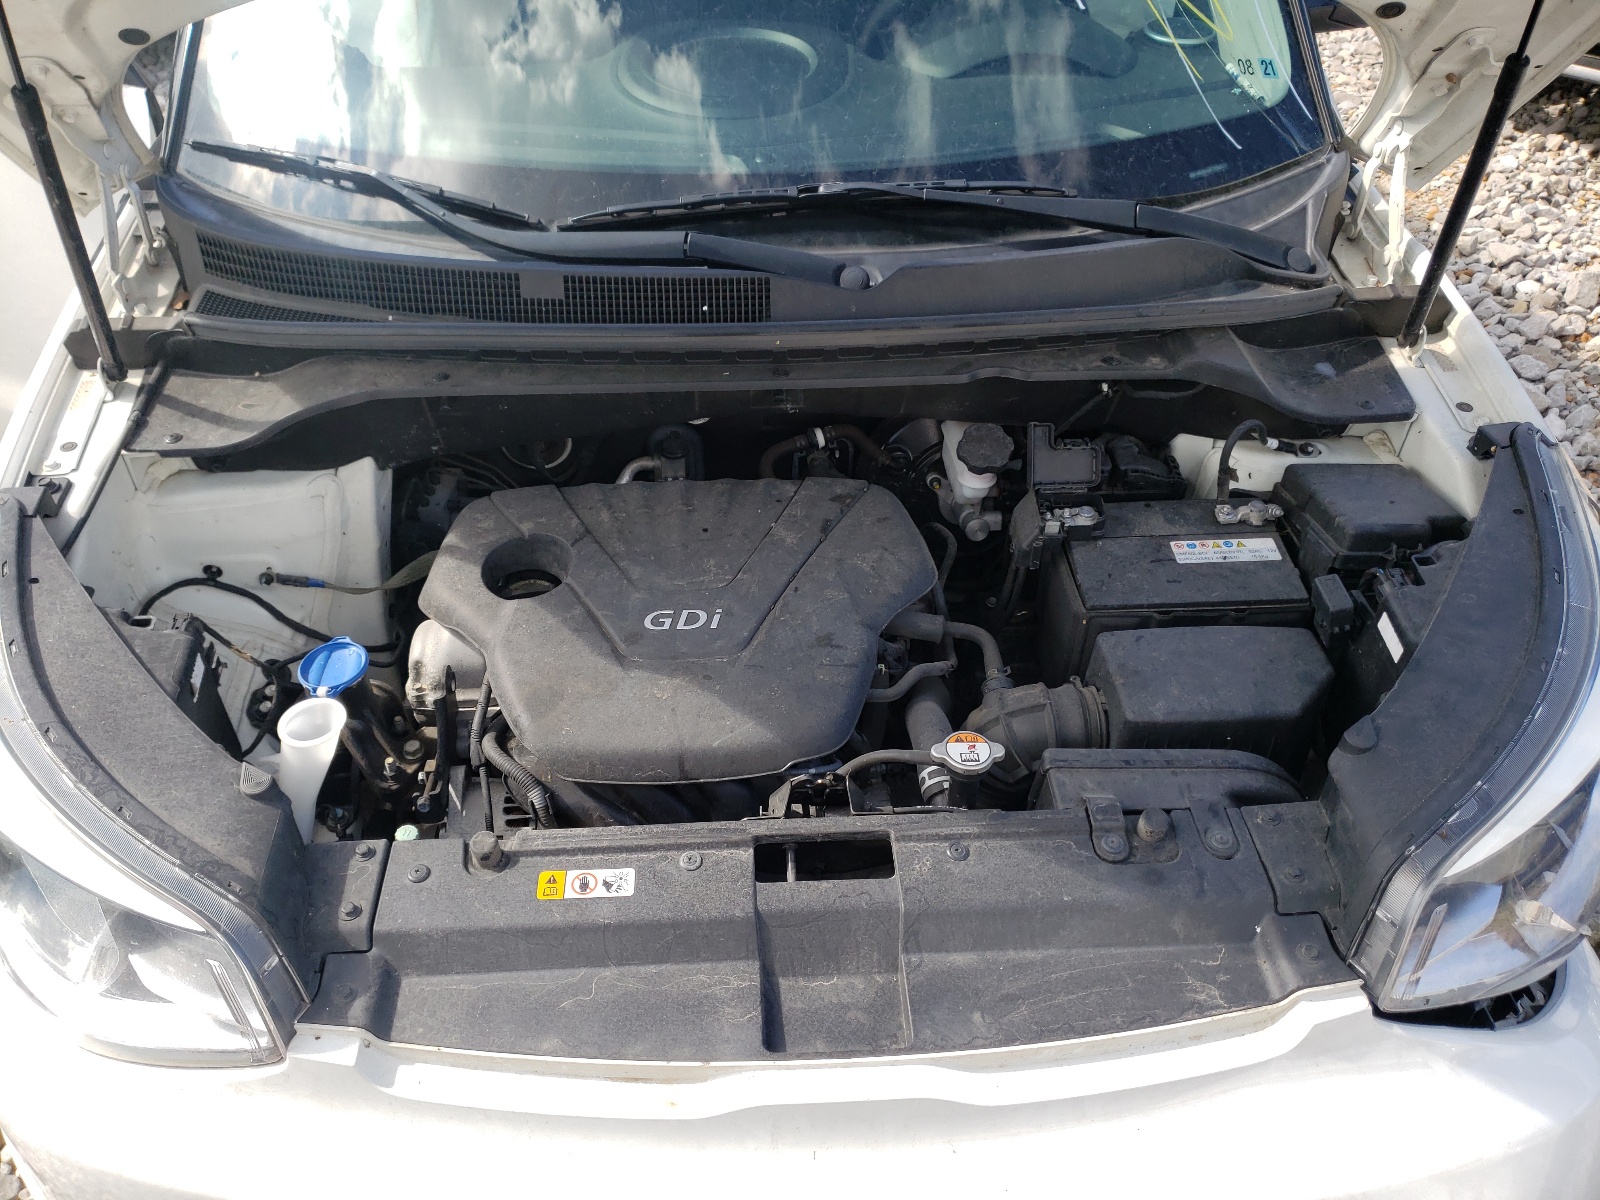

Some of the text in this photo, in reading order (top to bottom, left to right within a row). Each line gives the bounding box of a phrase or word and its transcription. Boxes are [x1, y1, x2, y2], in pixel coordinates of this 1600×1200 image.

[1237, 58, 1277, 76] 08 21
[643, 608, 723, 630] GDi
